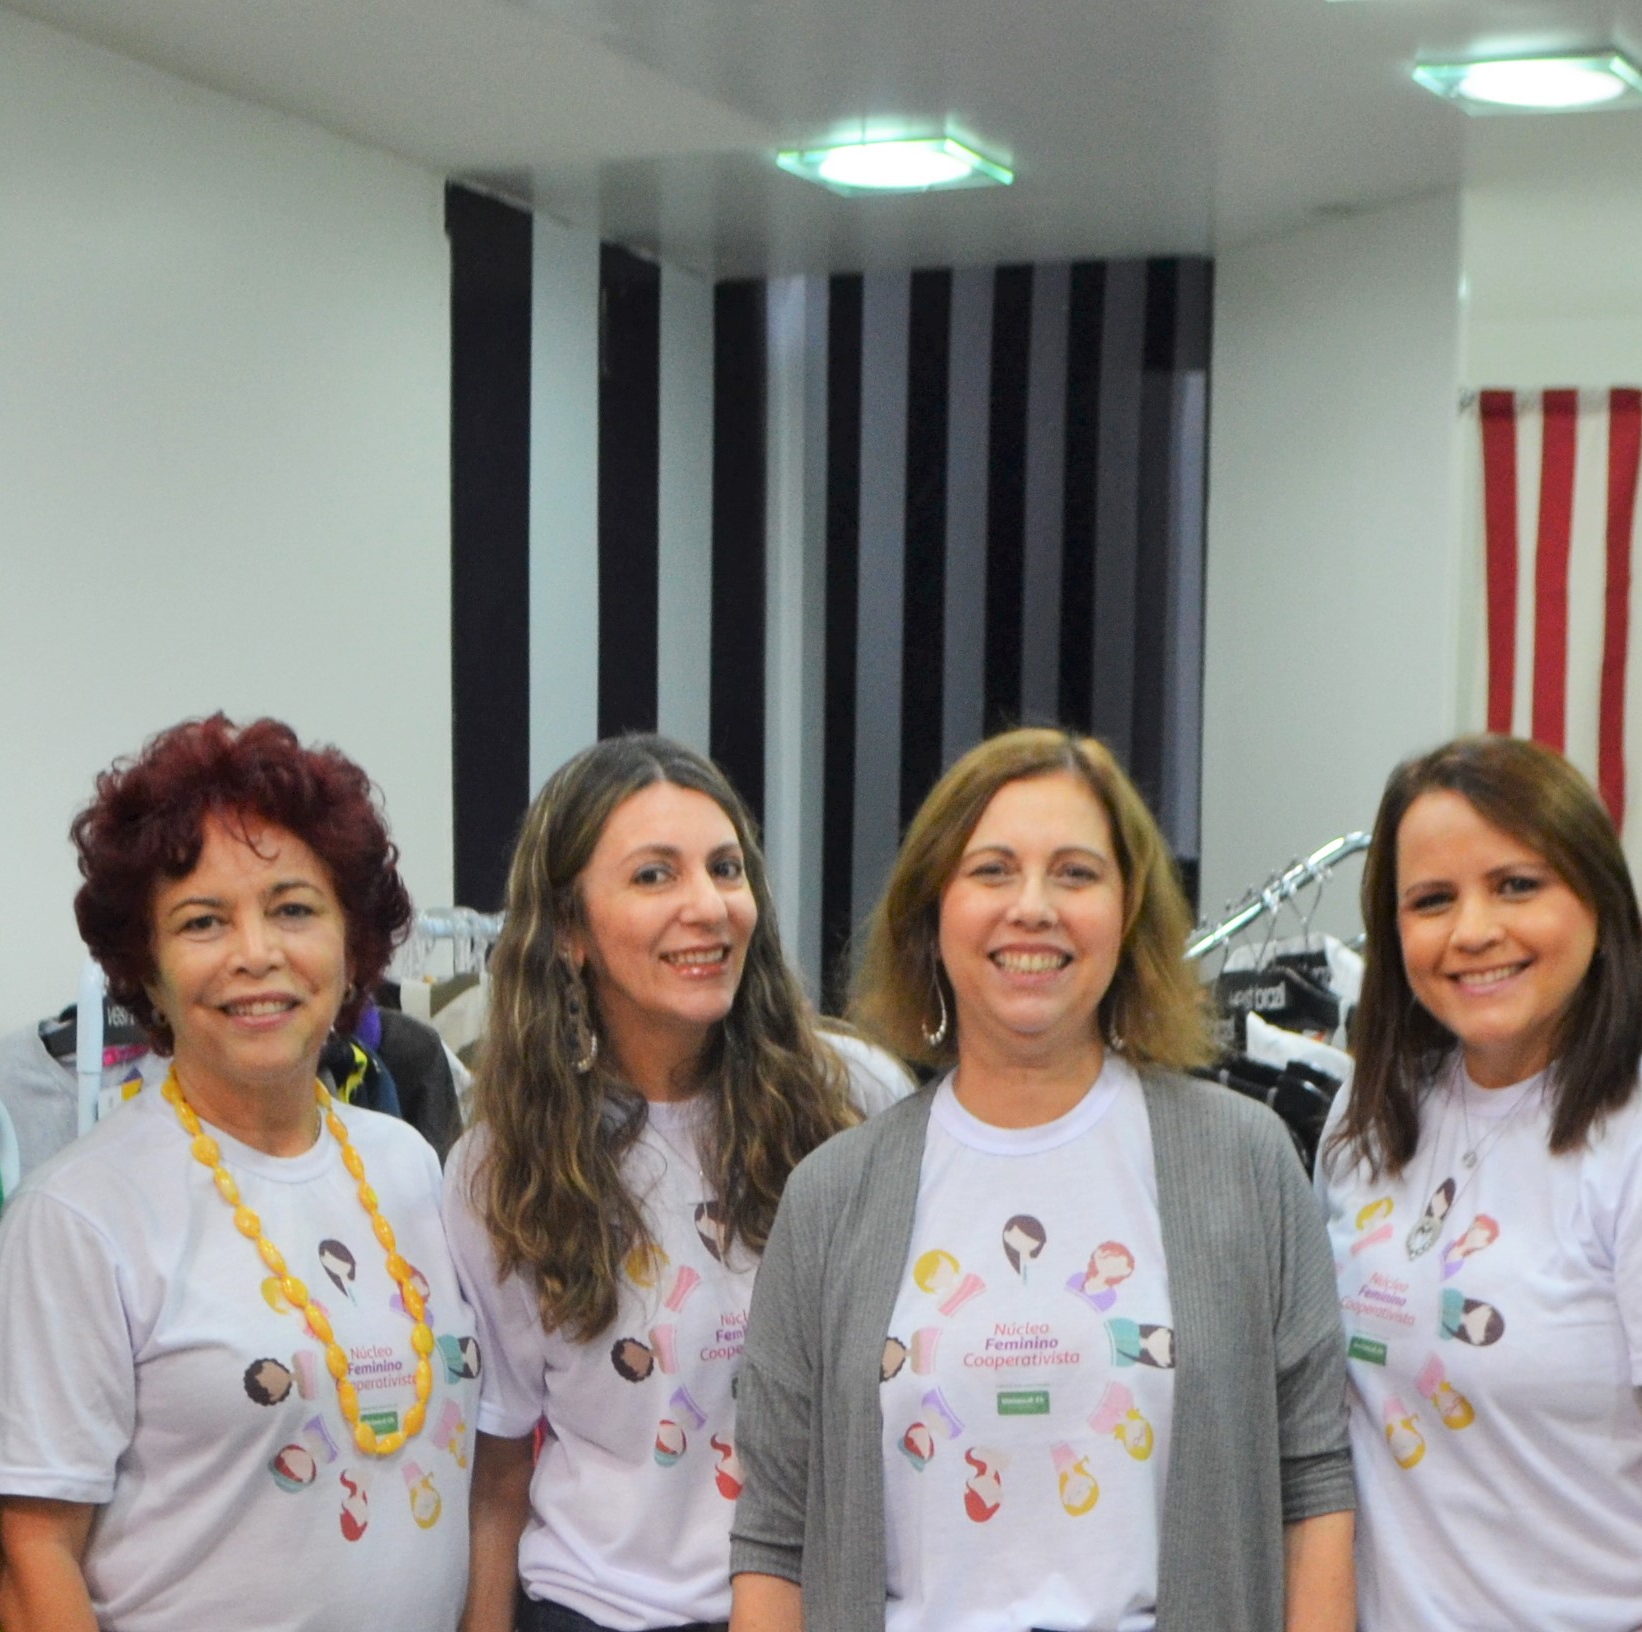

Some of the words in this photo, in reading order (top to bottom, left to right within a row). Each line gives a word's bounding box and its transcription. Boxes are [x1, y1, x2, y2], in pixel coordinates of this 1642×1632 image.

[994, 1321, 1050, 1336] Núcleo
[984, 1336, 1059, 1350] Feminino
[348, 1360, 402, 1375] Feminino
[963, 1350, 1080, 1370] Cooperativista
